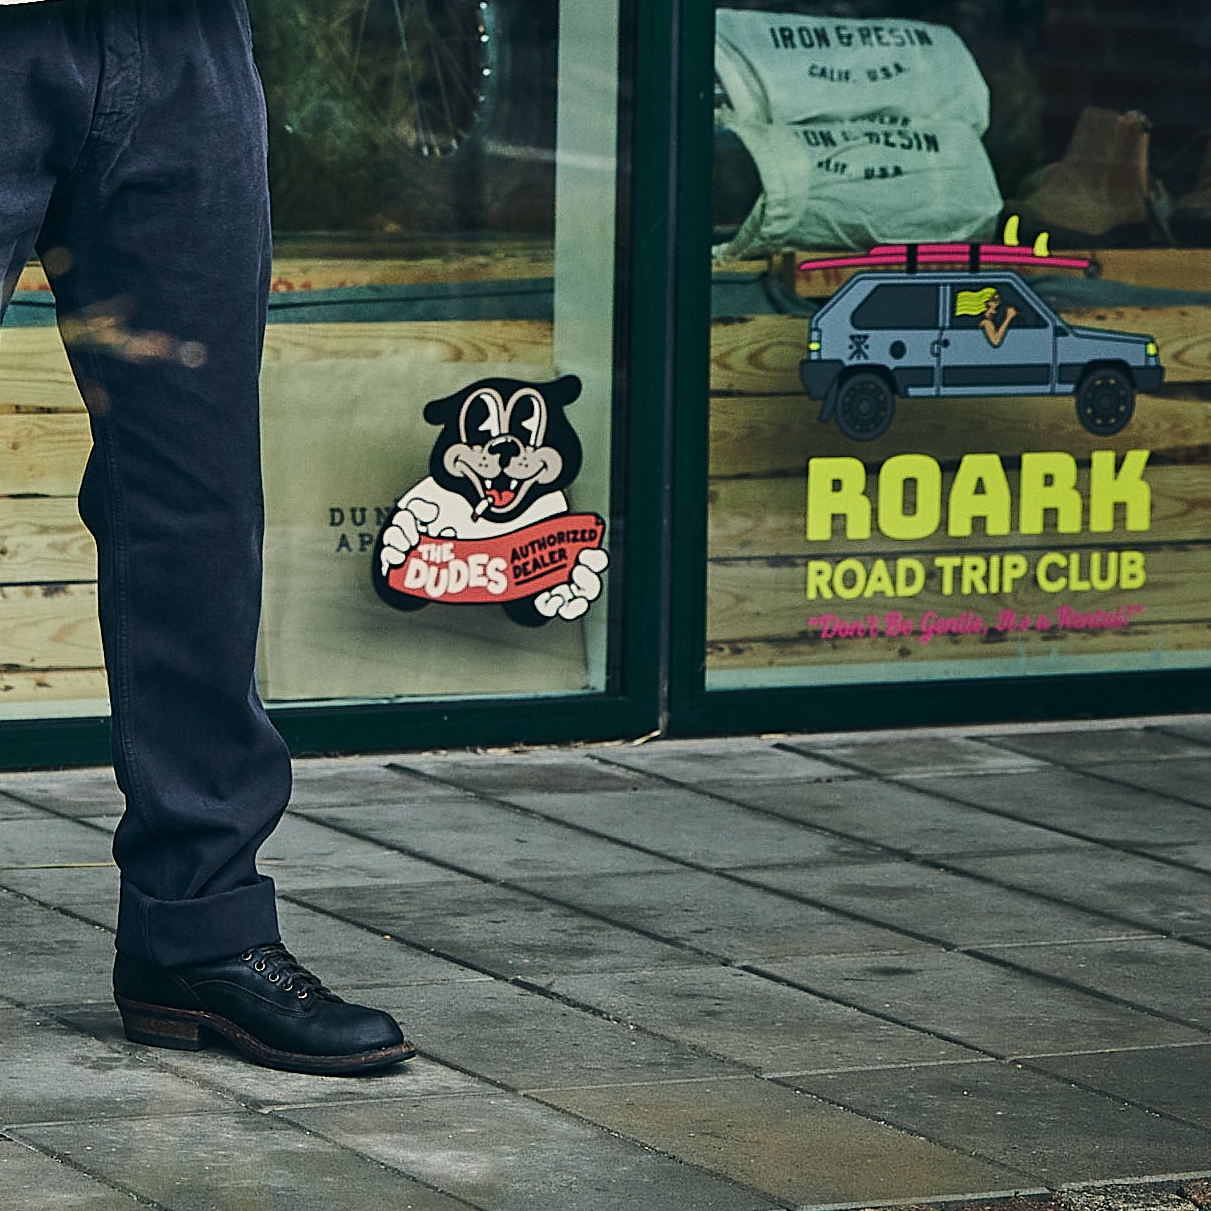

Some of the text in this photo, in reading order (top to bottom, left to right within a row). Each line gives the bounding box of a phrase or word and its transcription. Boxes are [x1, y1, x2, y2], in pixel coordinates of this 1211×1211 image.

[770, 25, 934, 49] IRON & RESIN
[807, 62, 858, 83] CALIF.
[794, 129, 838, 148] ON
[805, 449, 1152, 541] ROARK
[417, 542, 455, 564] THE
[510, 528, 598, 564] AUTHORIZED
[404, 552, 509, 598] DUDES
[513, 547, 568, 579] DEALER
[806, 551, 1147, 600] ROAD TRIP CLUB
[885, 611, 913, 637] Be
